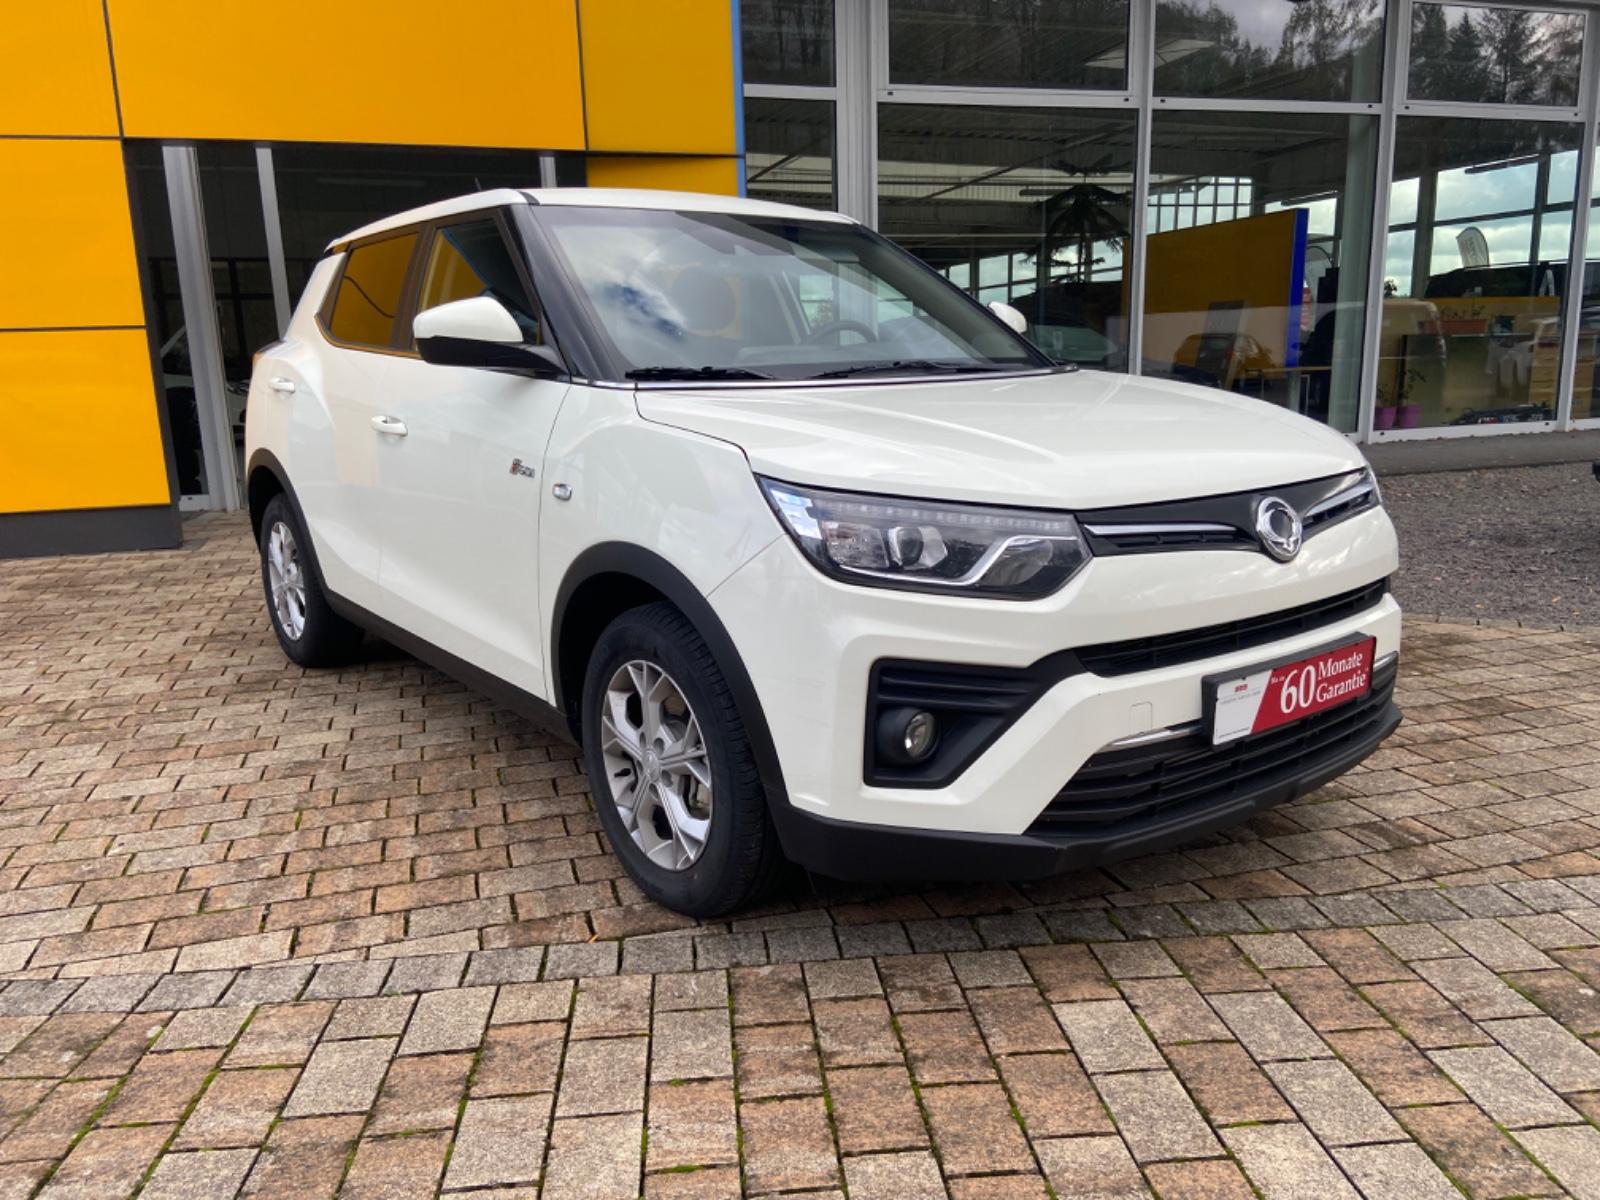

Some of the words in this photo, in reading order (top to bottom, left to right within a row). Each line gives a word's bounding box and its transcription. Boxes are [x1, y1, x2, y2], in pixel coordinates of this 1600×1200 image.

[1281, 665, 1316, 714] 60
[1318, 652, 1363, 680] Monate
[1316, 670, 1366, 703] Garantie
